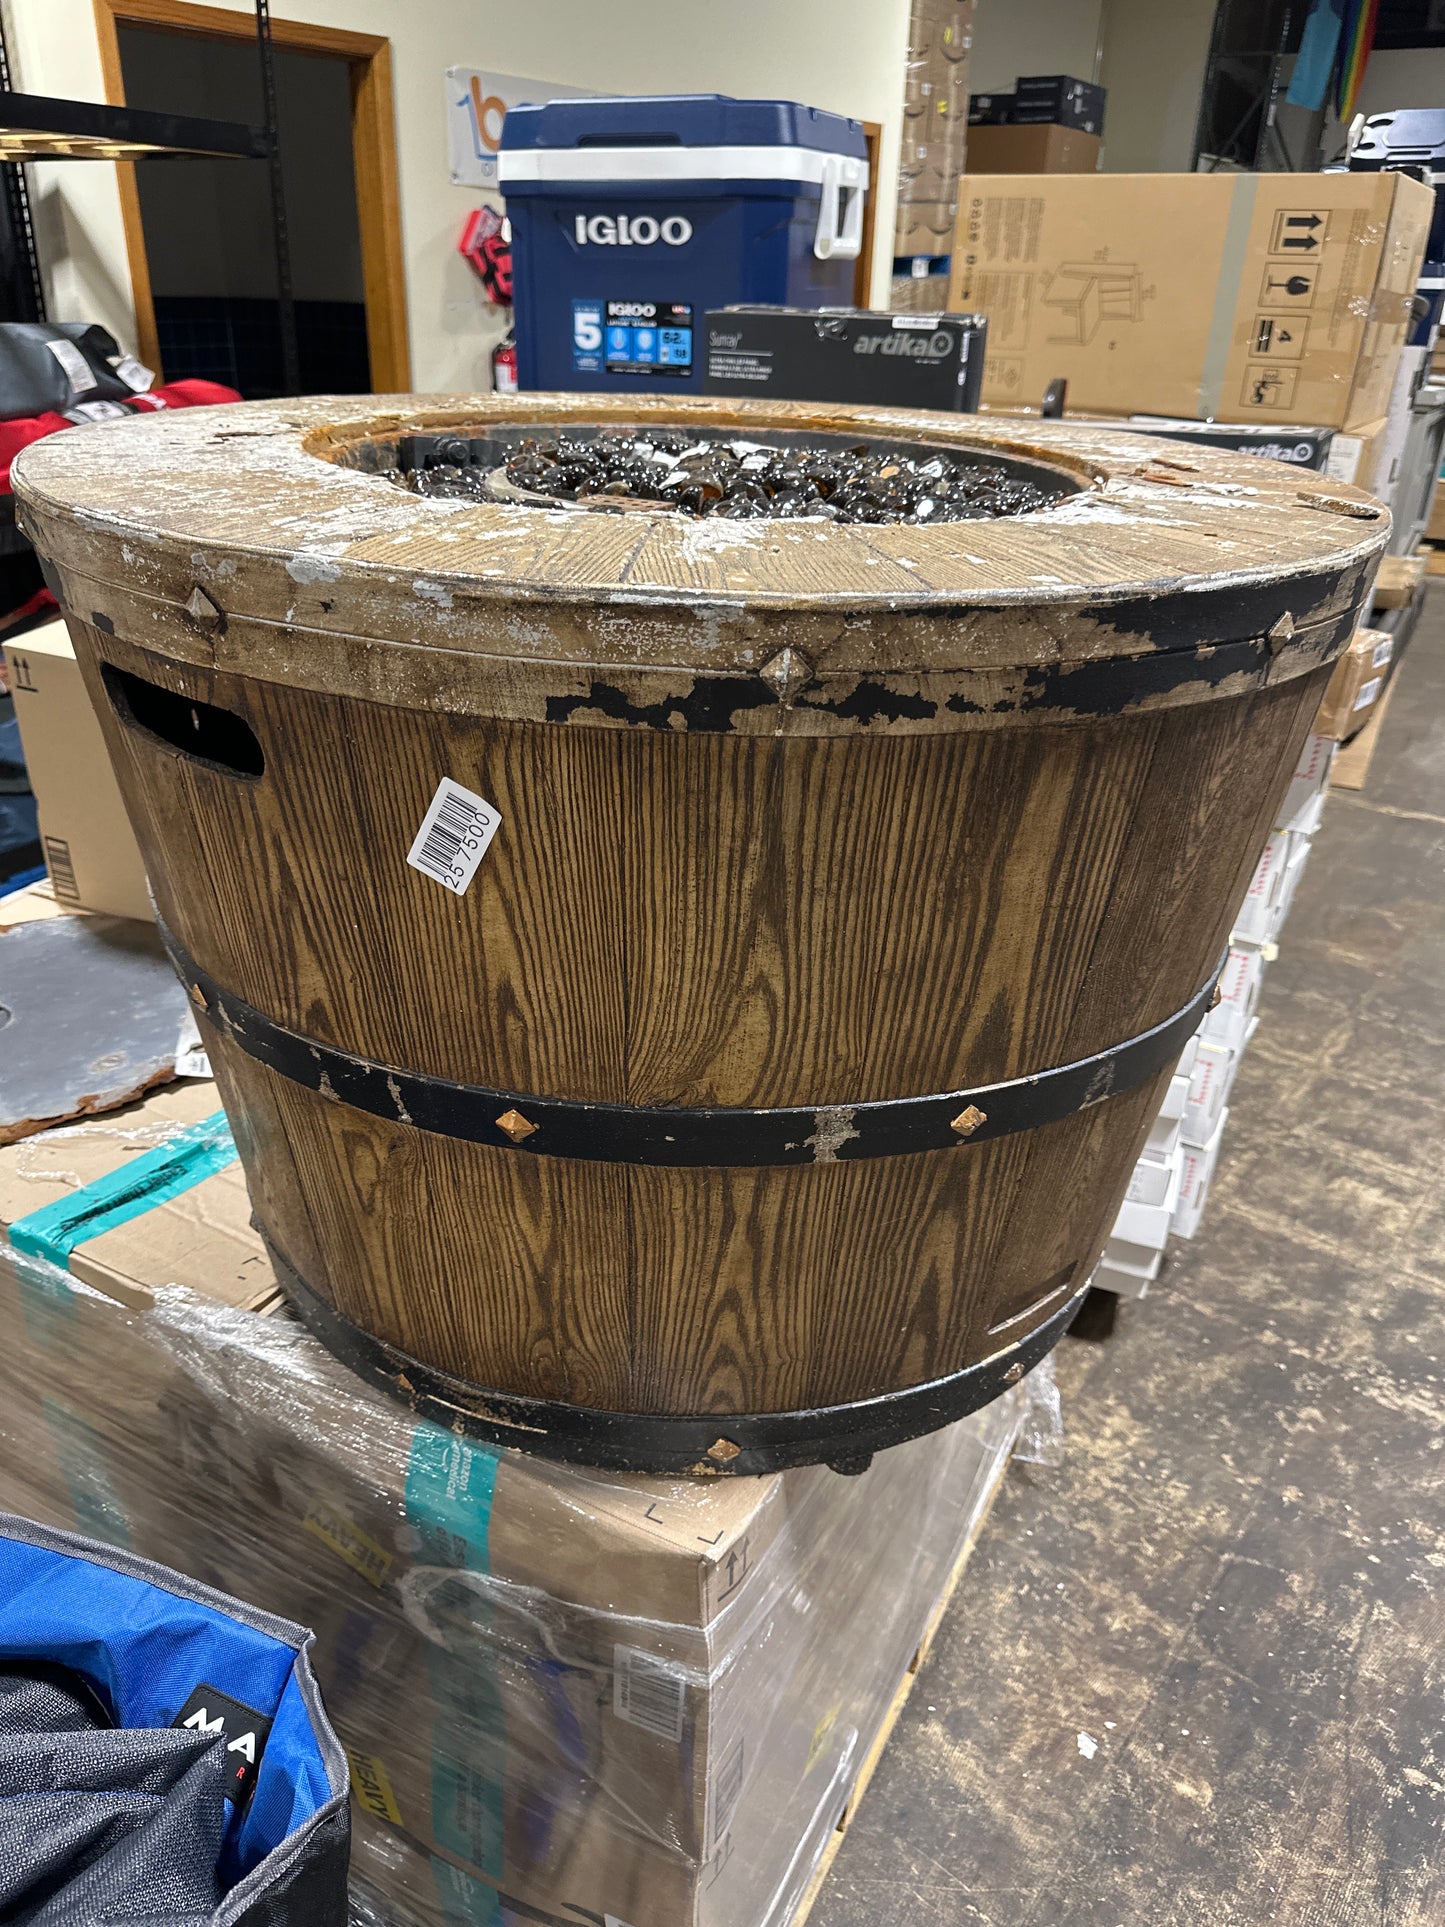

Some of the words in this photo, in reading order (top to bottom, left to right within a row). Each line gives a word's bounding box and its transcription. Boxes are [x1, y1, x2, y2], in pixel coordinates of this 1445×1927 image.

[575, 215, 693, 246] IGLOO
[608, 302, 657, 318] IGLOO
[574, 312, 602, 351] 5
[853, 331, 932, 357] artika
[350, 1749, 391, 1819] HEAVY
